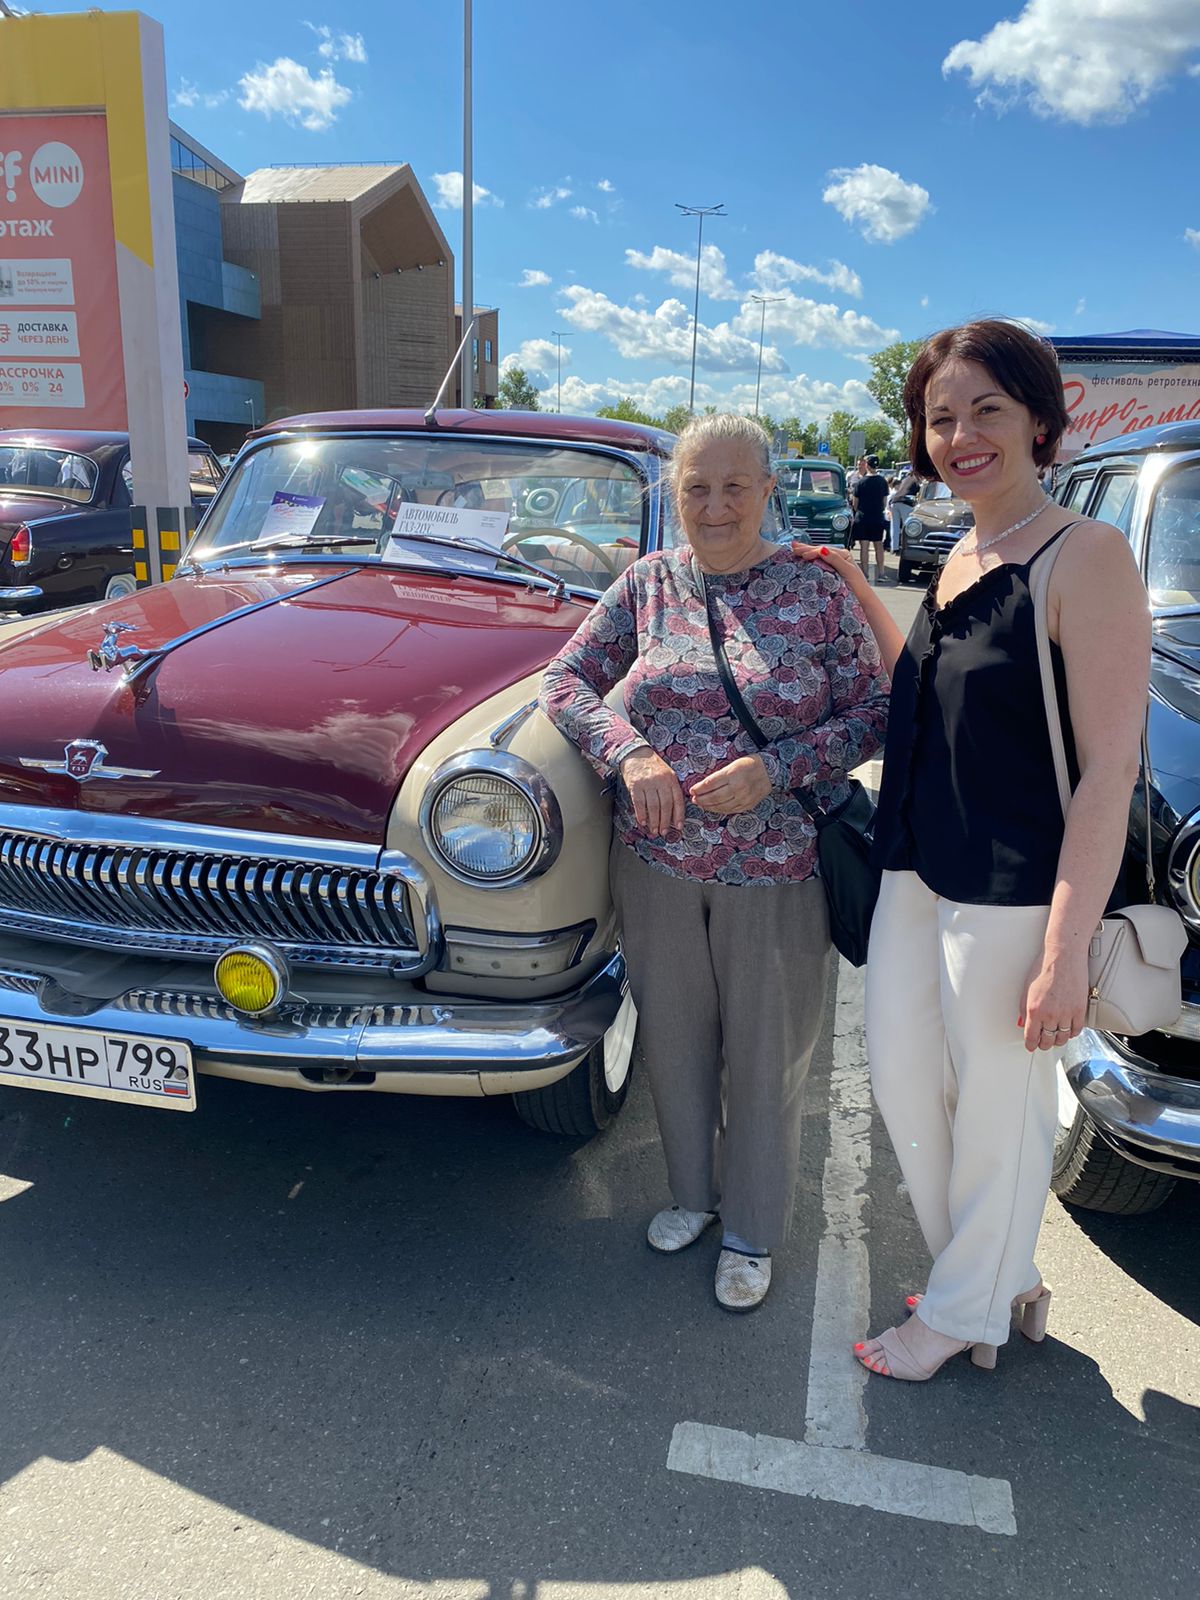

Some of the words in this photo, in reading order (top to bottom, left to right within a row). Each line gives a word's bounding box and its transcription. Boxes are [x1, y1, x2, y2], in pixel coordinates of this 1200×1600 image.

[34, 166, 79, 184] MINI
[18, 323, 68, 333] ДОСТАВКА
[18, 335, 43, 343] ЧЕРЕЗ
[45, 336, 69, 344] ДЕНЬ
[0, 368, 64, 379] АССРОЧКА
[22, 381, 39, 392] 0%
[48, 383, 63, 393] 24
[1091, 374, 1143, 386] фестиваль
[1148, 377, 1200, 389] ретротехн
[403, 508, 459, 524] АВТОМОБИЛЬ
[109, 1040, 176, 1078] 799
[129, 1076, 163, 1091] RUS
